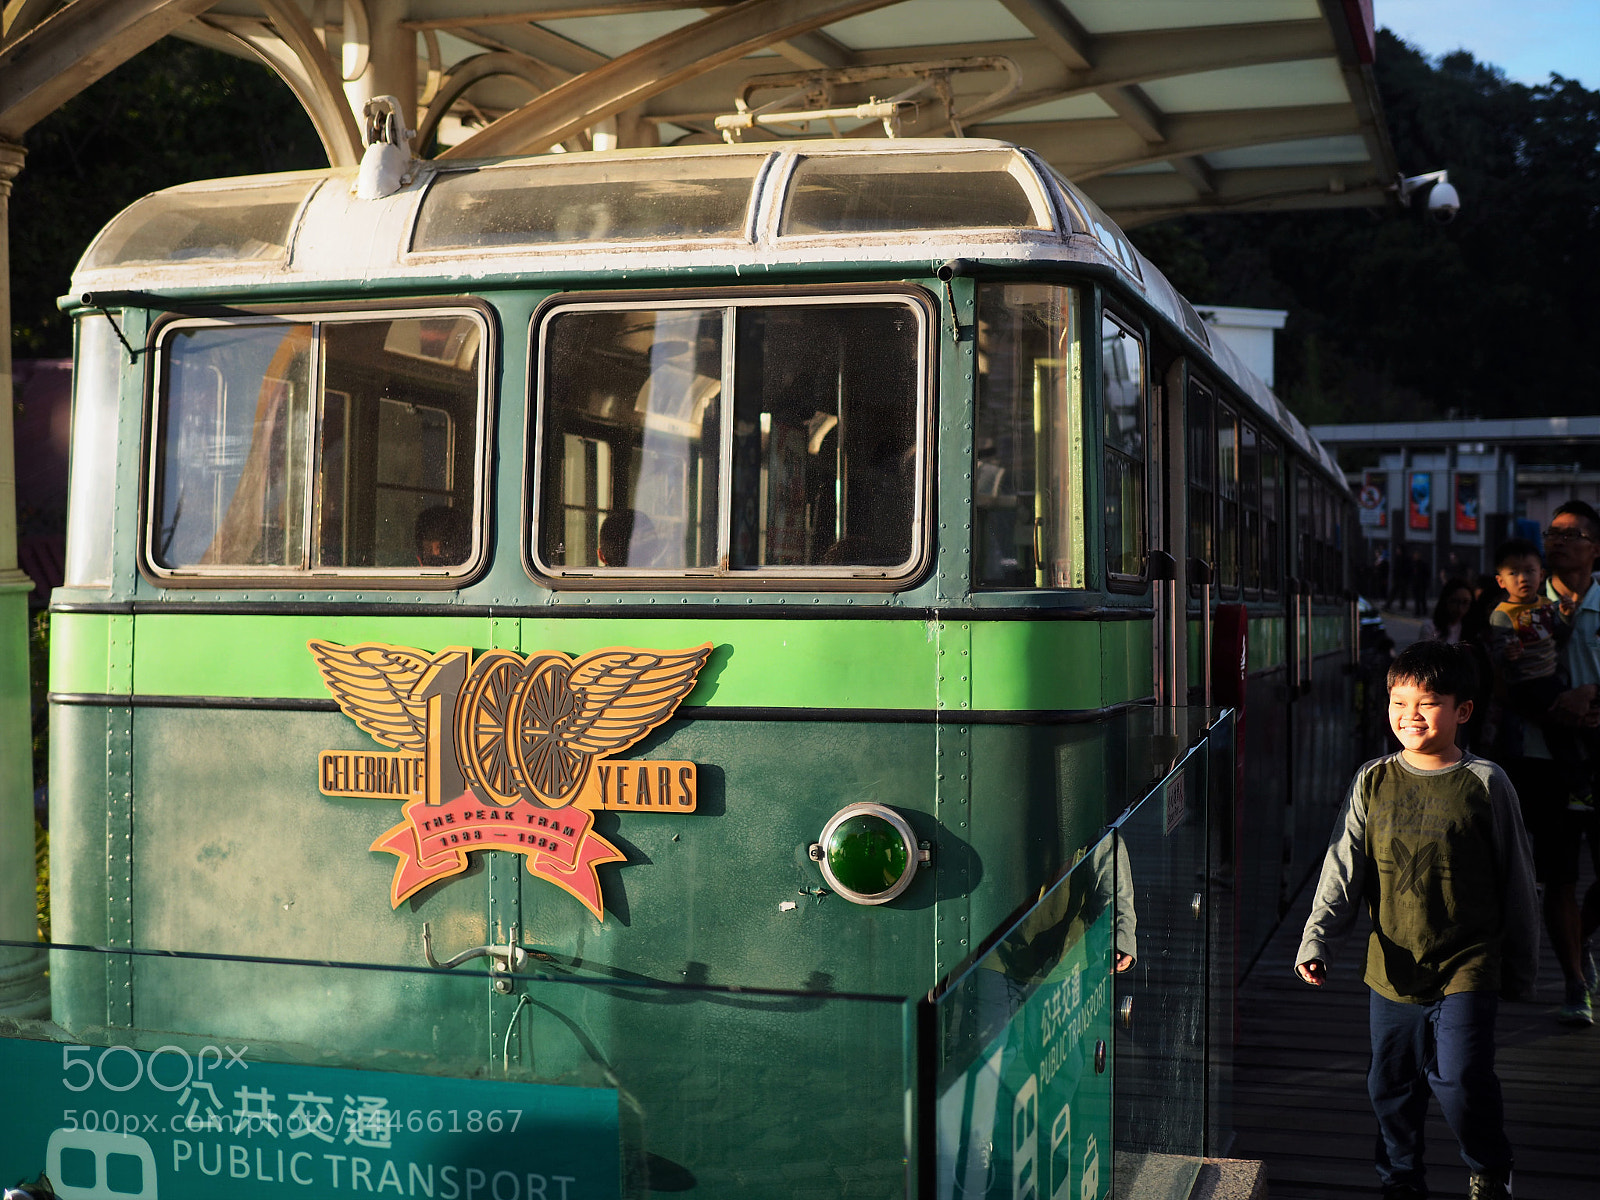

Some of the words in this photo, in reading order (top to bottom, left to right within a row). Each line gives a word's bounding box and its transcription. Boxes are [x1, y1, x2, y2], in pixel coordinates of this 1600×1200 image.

[597, 765, 692, 806] YEARS
[422, 813, 455, 831] THE
[464, 810, 514, 821] PEAK
[526, 814, 576, 837] TRAM
[439, 830, 482, 846] 1888
[518, 832, 559, 851] 1988
[1040, 1030, 1067, 1093] PUBLIC
[1067, 976, 1107, 1052] TRANSPORT
[1041, 961, 1080, 1047] 公共交通
[177, 1081, 392, 1149] 公共交通
[173, 1139, 313, 1185] PUBLIC
[323, 1154, 576, 1200] TRANSPORT
